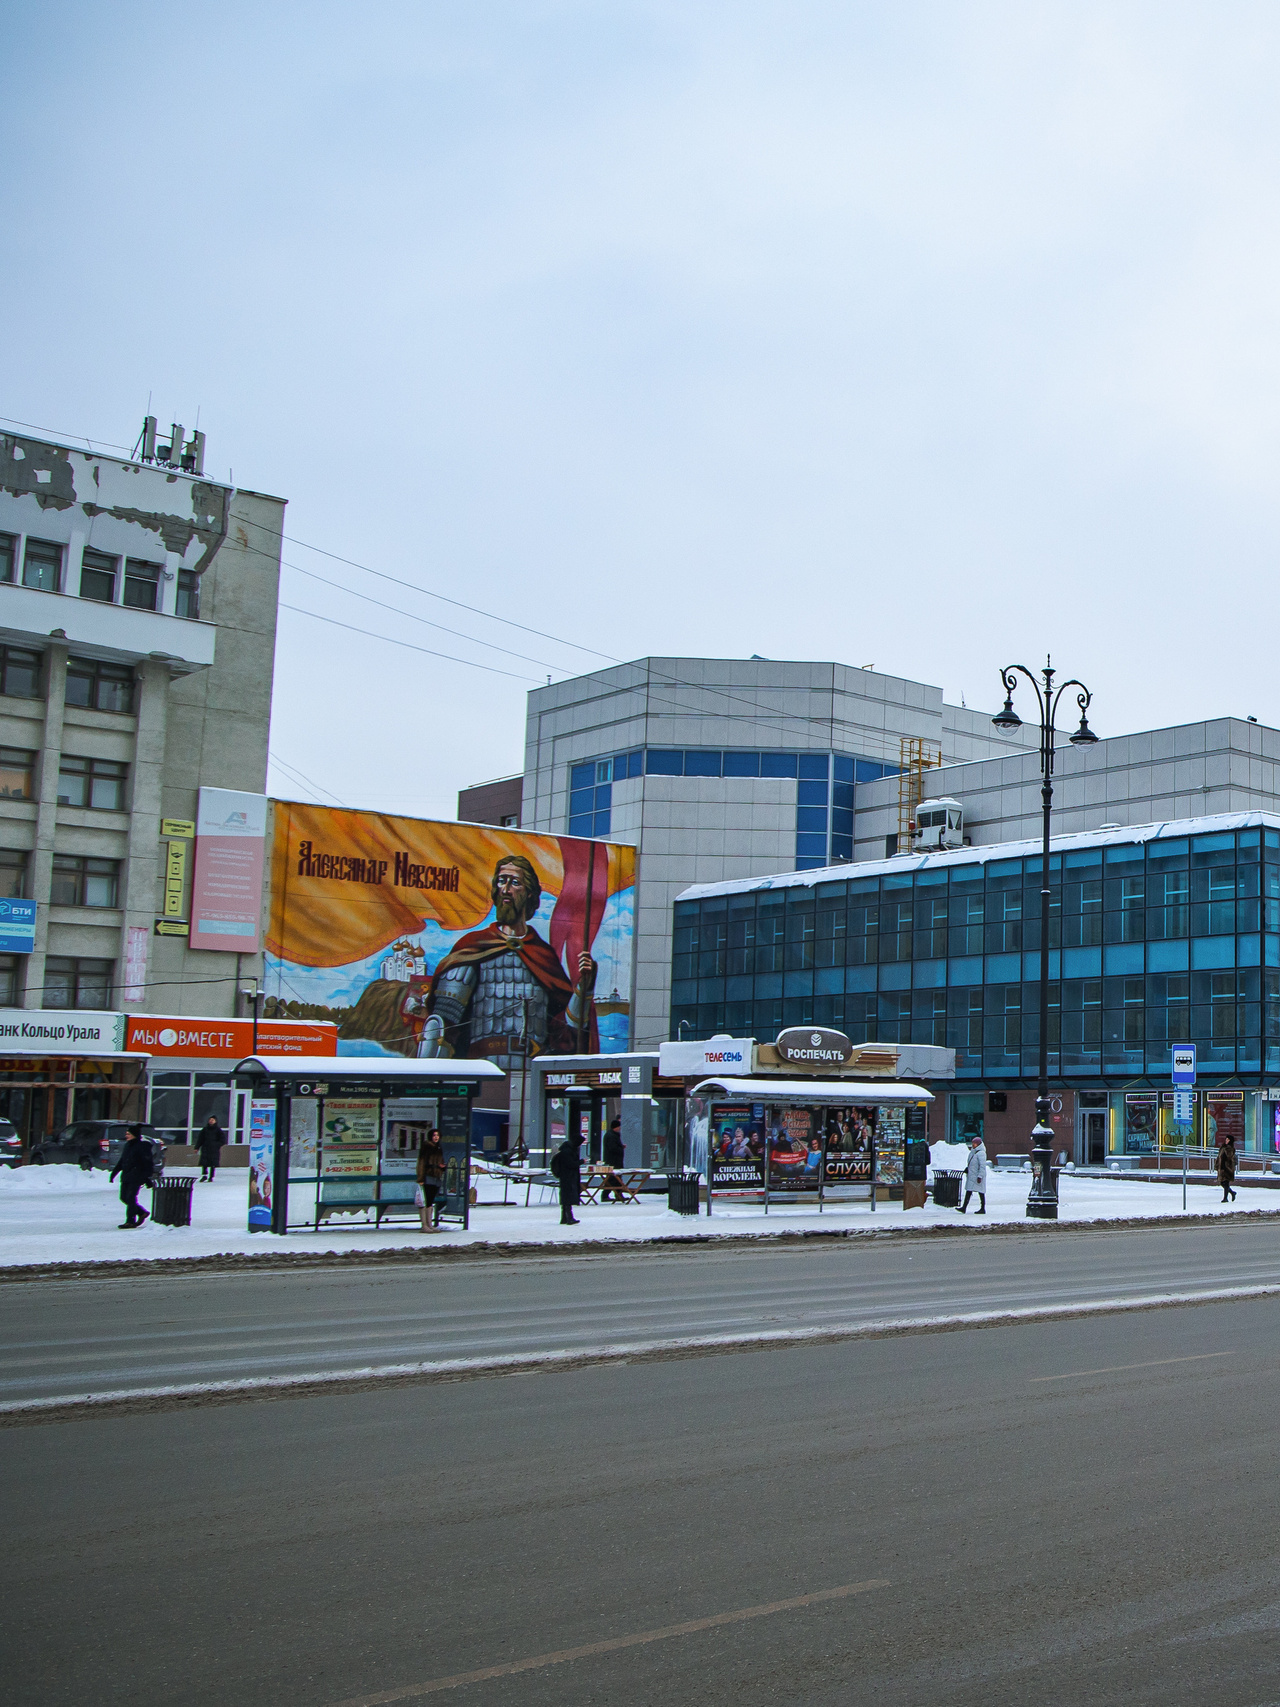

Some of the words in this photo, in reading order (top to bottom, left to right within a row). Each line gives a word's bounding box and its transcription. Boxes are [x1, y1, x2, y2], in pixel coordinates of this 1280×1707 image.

[394, 851, 460, 893] Невский
[12, 907, 32, 916] БТИ
[21, 1023, 65, 1040] Кольцо
[67, 1024, 100, 1042] Урала
[131, 1029, 158, 1045] МЫ
[178, 1031, 235, 1048] ВМЕСТЕ
[283, 1044, 302, 1052] фонд
[787, 1048, 844, 1061] РОСПЕЧАТЬ
[547, 1074, 576, 1085] ТУАЛЕТ
[598, 1072, 622, 1084] ТАБАК
[719, 1165, 756, 1173] СНЕЖНАЯ
[825, 1162, 871, 1175] СЛУХИ
[713, 1172, 762, 1182] КОРОЛЕВА
